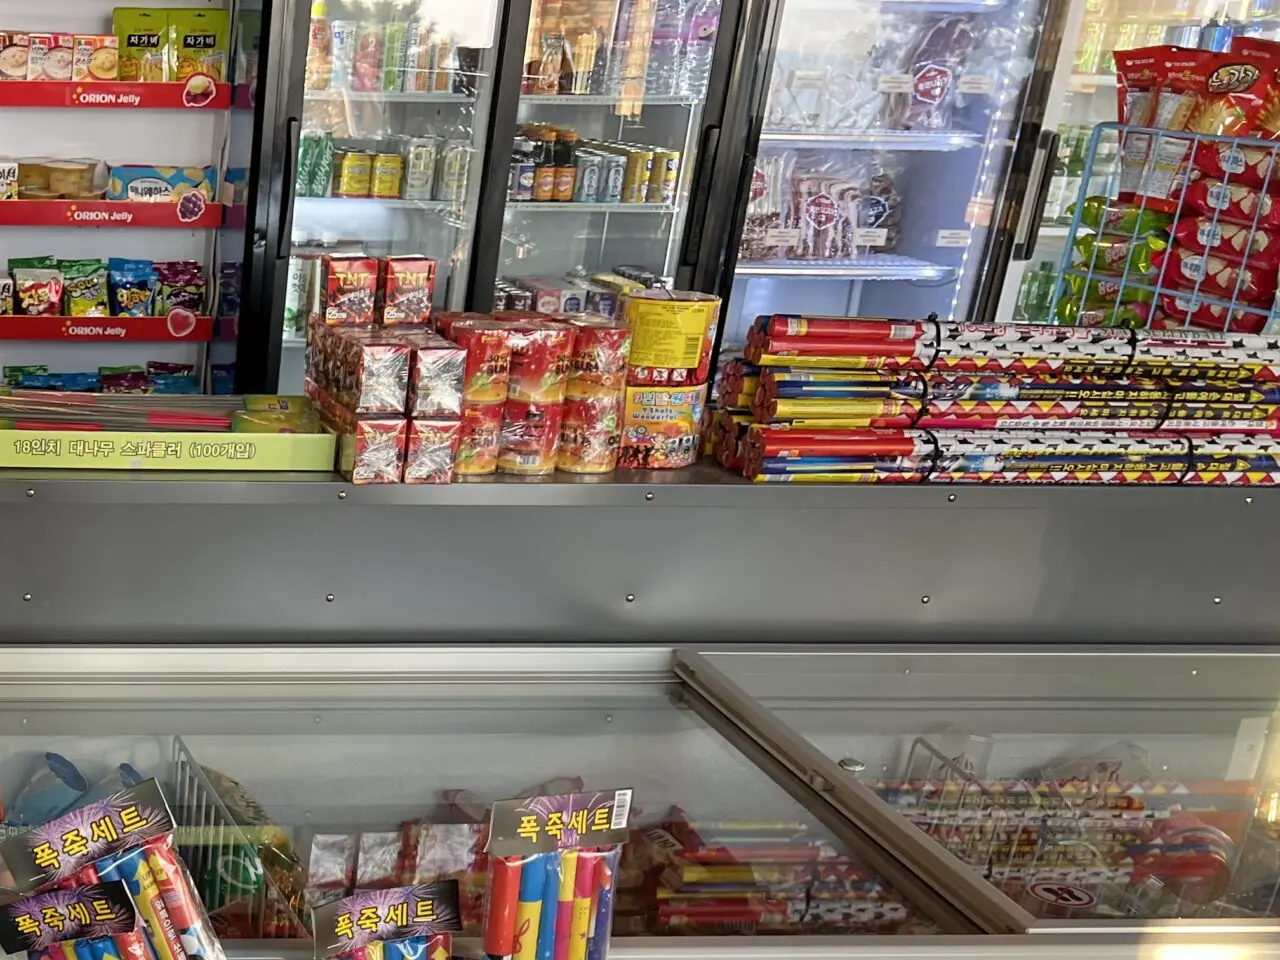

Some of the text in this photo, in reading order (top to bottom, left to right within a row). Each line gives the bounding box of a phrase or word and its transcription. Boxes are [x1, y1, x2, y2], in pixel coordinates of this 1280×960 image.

[185, 36, 215, 46] 자가비
[79, 94, 141, 106] ORION Jelly
[73, 211, 133, 222] ORION Jelly
[335, 271, 371, 288] TNT
[394, 271, 428, 288] TNT
[69, 326, 126, 337] ORION Jelly
[13, 439, 256, 459] 18인치 대나무 스파클러 (100개입)
[517, 808, 613, 846] 폭죽세트
[33, 805, 149, 870] 폭죽세트
[15, 899, 117, 937] 폭죽세트
[334, 899, 440, 940] 폭죽세트
